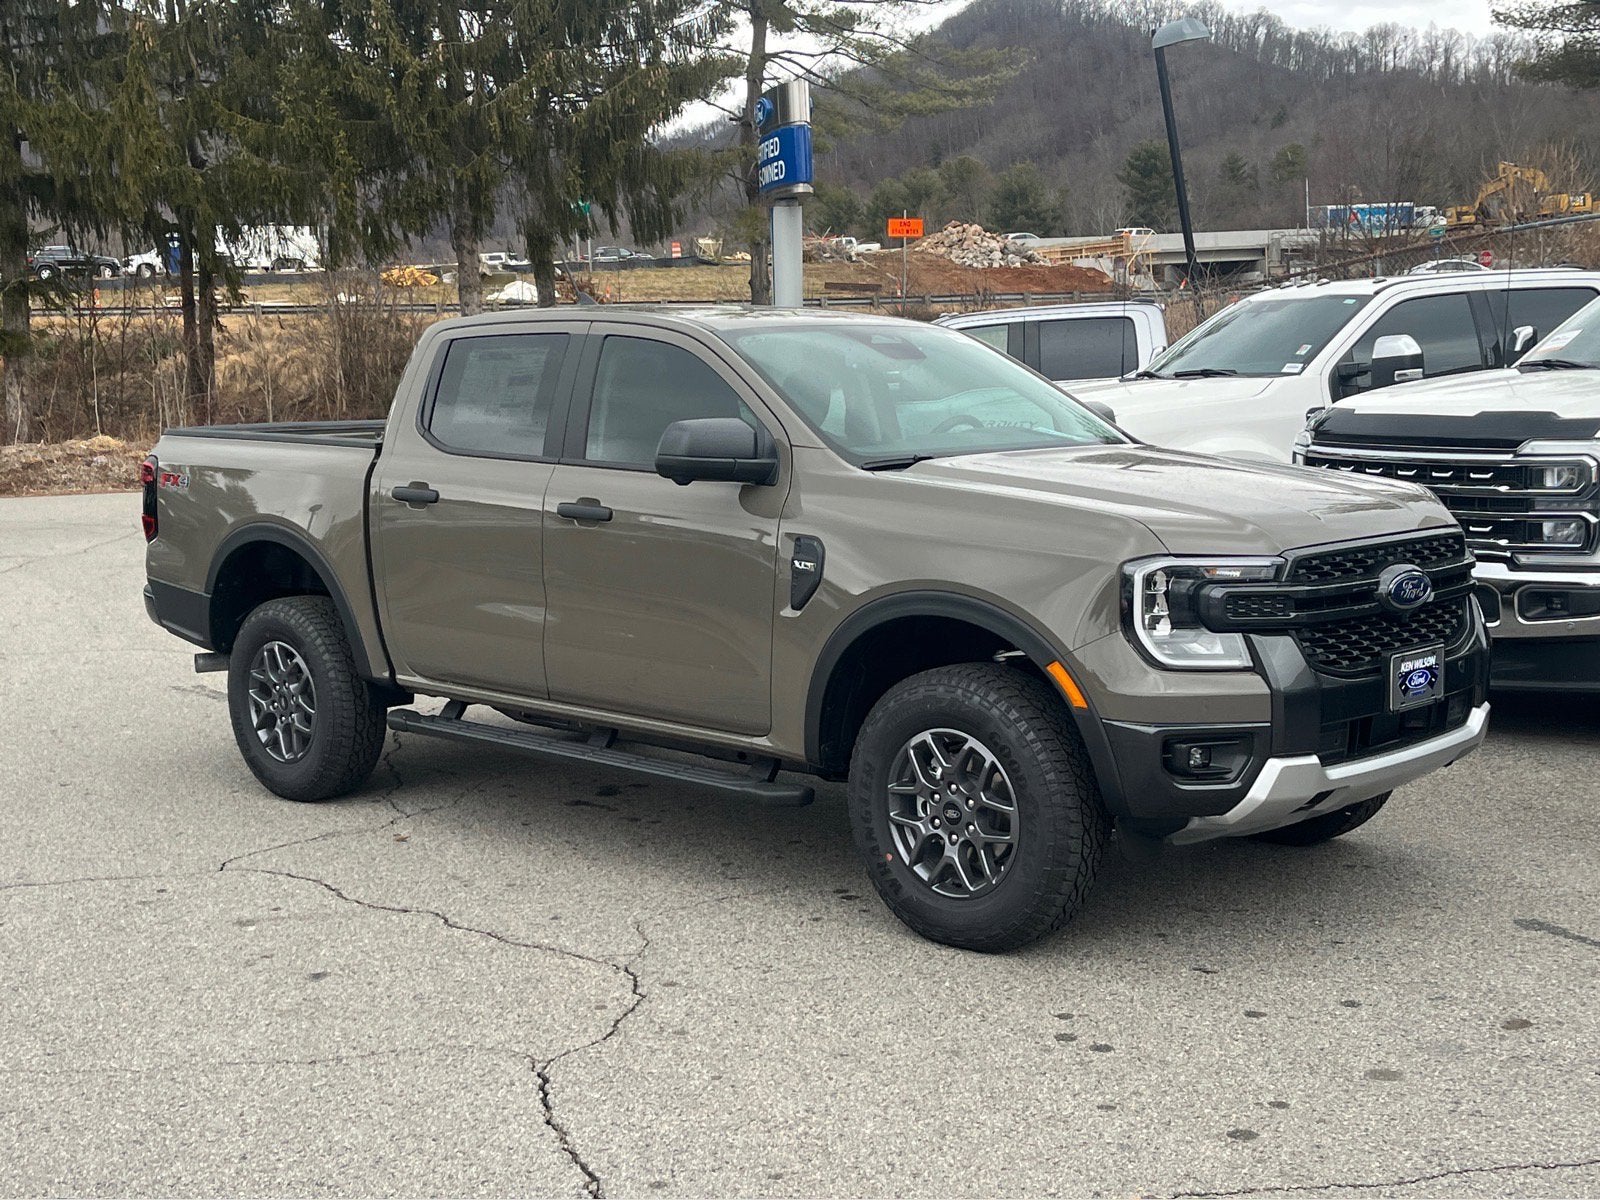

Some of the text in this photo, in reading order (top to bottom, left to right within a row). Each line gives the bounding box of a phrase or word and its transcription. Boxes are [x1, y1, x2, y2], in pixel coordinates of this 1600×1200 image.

[1401, 579, 1425, 599] Ford
[1400, 655, 1437, 673] KEN WILSON
[1410, 672, 1426, 686] Ford
